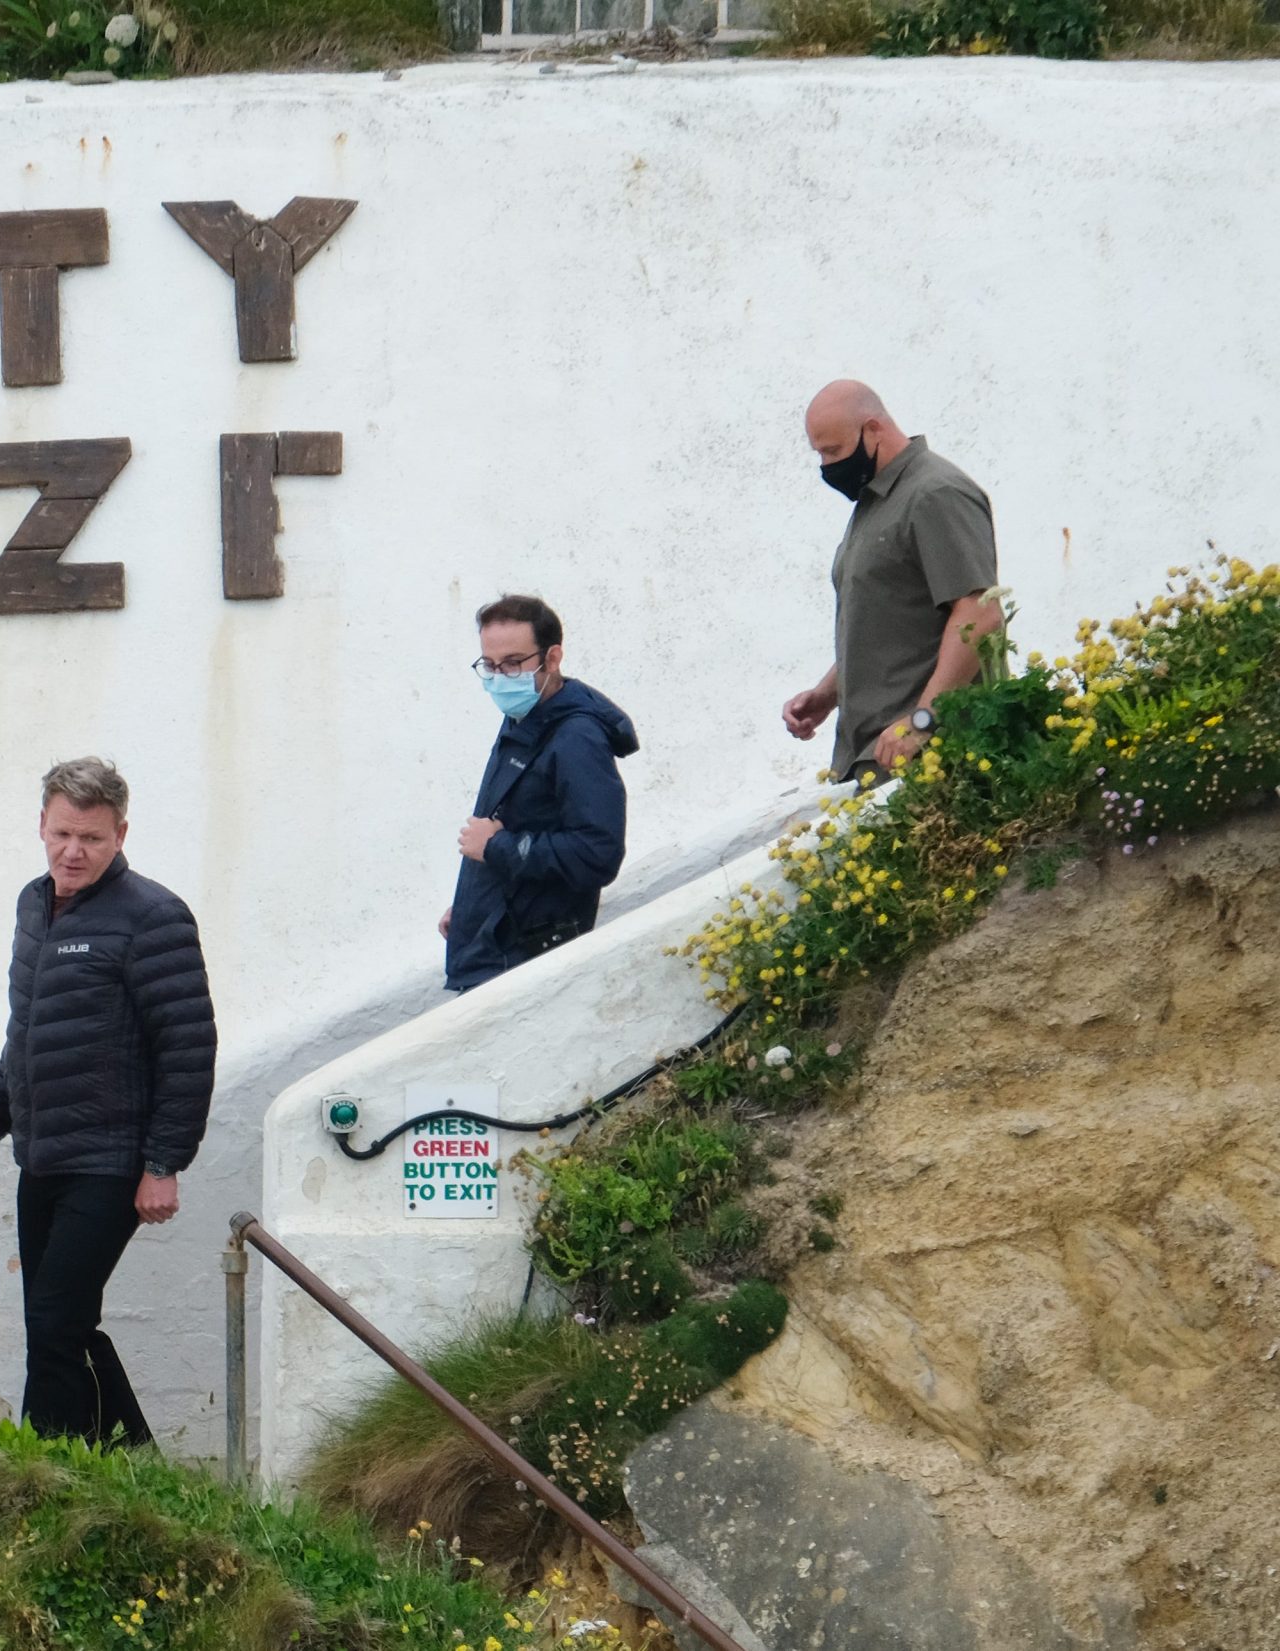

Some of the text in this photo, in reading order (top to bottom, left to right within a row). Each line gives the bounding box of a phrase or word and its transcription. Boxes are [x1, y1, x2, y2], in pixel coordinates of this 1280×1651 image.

[57, 943, 90, 954] HUUB
[413, 1118, 488, 1136] PRESS
[413, 1140, 489, 1157] GREEN
[403, 1162, 498, 1179] BUTTON
[405, 1184, 497, 1201] TO EXIT
